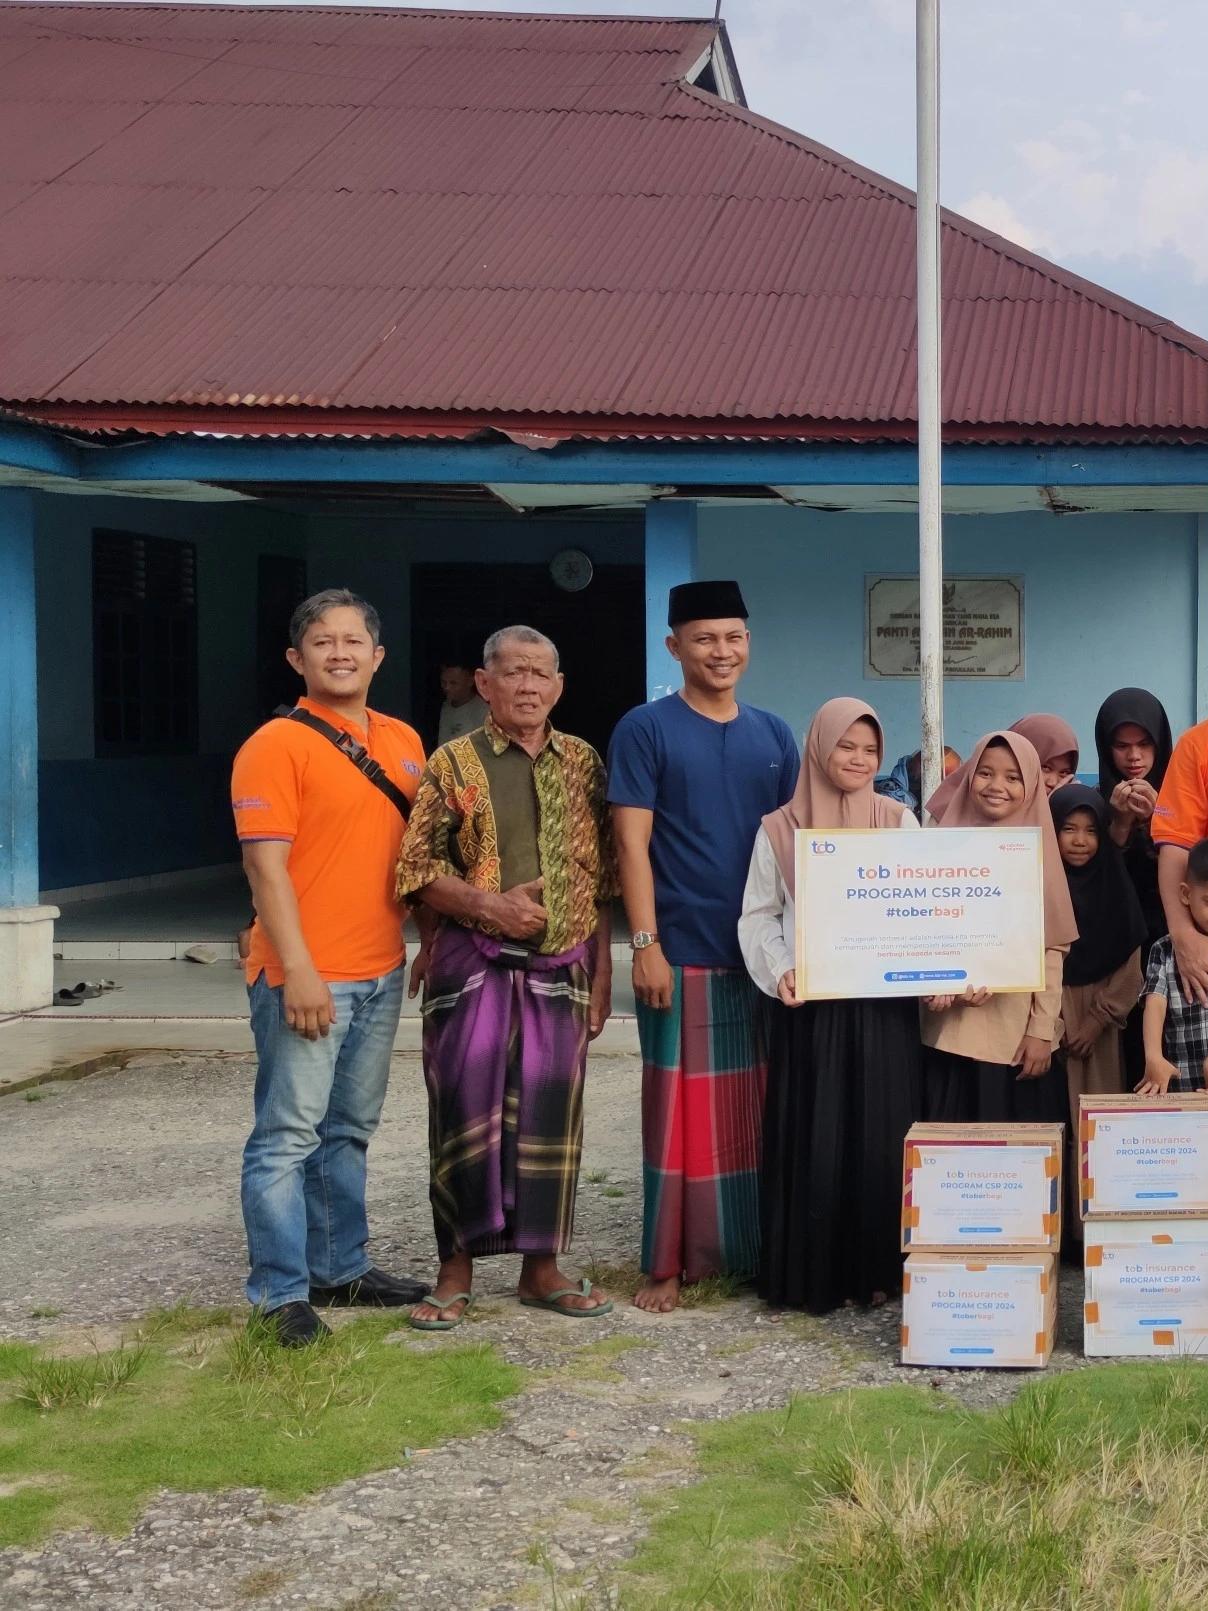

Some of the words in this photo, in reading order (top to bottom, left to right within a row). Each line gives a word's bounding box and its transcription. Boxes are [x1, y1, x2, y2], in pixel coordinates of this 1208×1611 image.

[858, 864, 890, 880] tob
[896, 864, 991, 879] insurance
[846, 887, 927, 899] PROGRAM
[931, 886, 961, 898] CSR
[966, 886, 1002, 898] 2024
[886, 906, 964, 919] #toberbagi
[1142, 1136, 1192, 1144] insurance
[967, 1170, 1018, 1179] insurance
[1145, 1264, 1196, 1272] insurance
[1119, 1276, 1162, 1284] PROGRAM
[958, 1290, 1010, 1298] insurance
